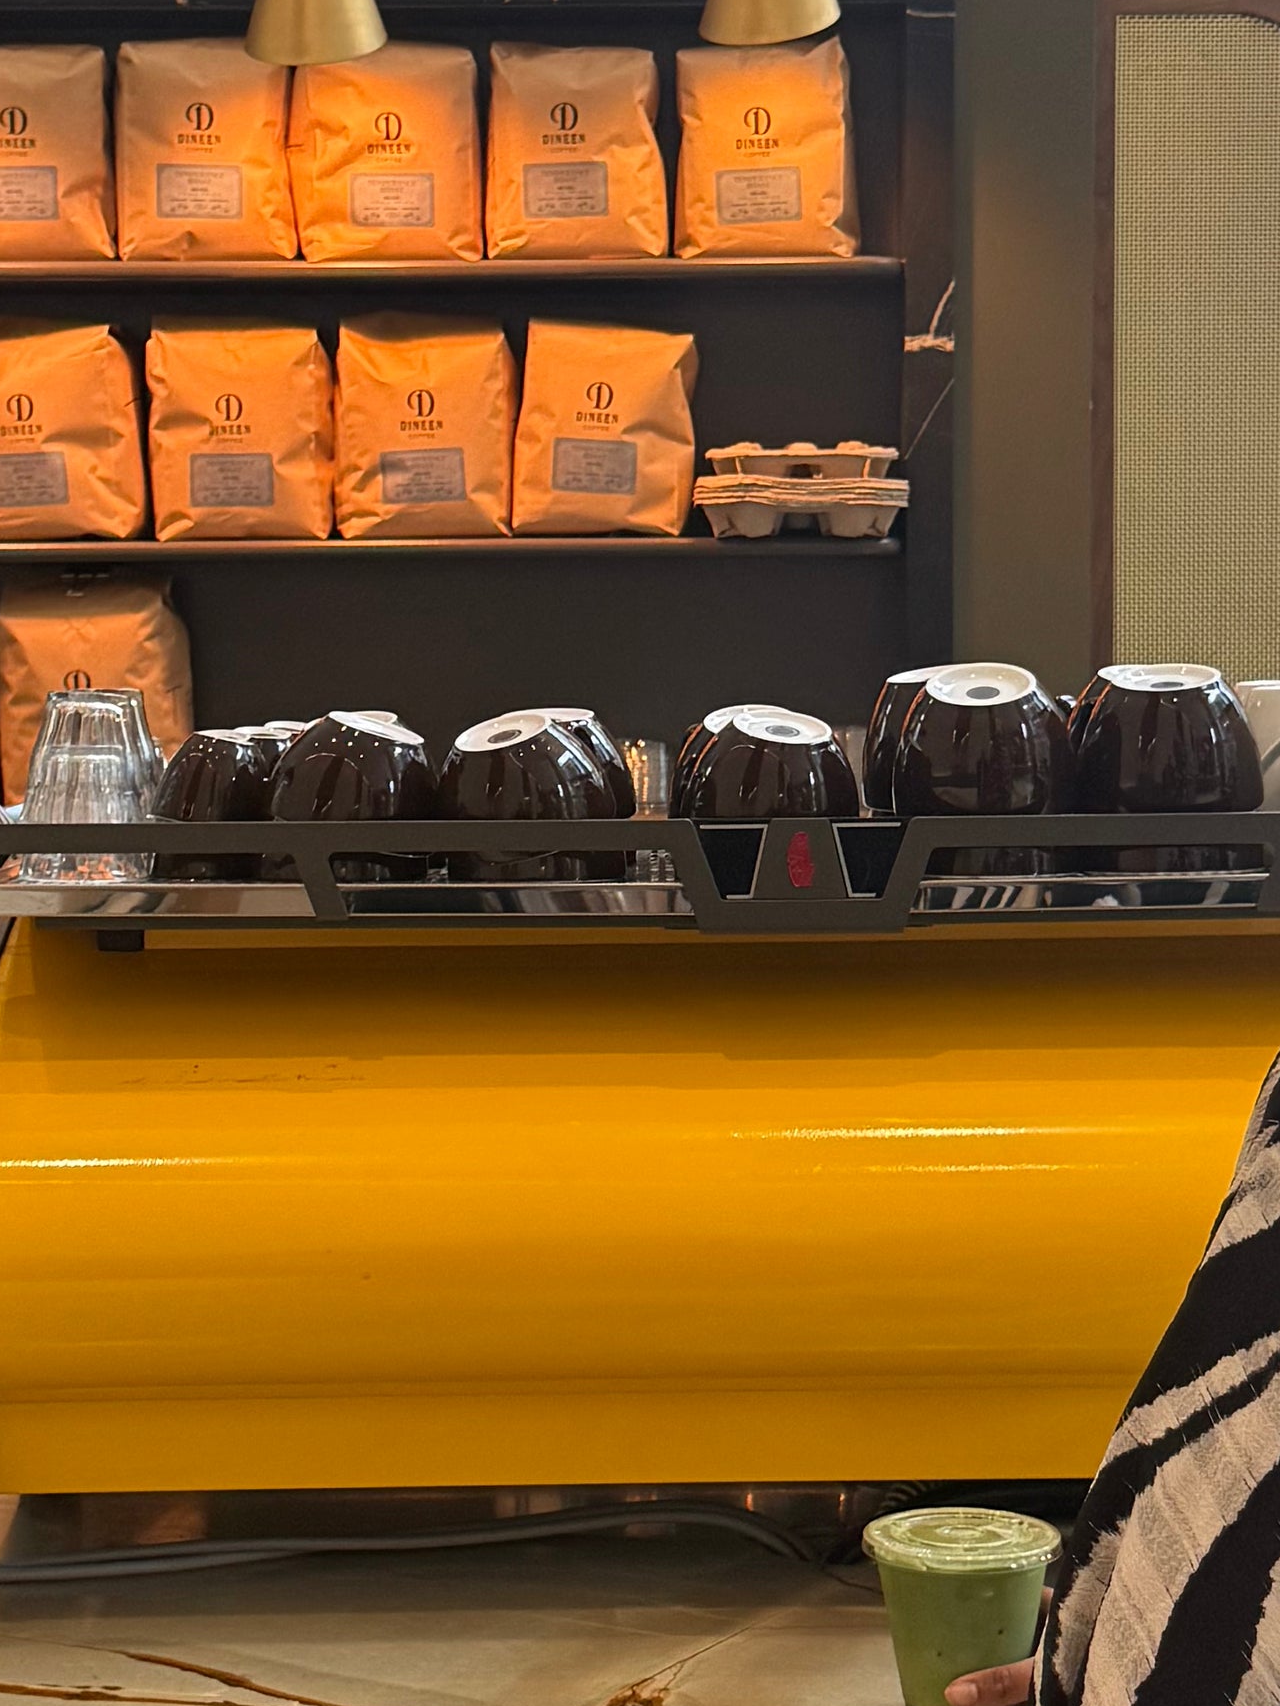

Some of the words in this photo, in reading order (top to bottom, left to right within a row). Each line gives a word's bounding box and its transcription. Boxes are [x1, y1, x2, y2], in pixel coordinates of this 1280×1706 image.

[177, 134, 221, 145] DINEEN
[542, 134, 586, 145] DINEEN
[735, 138, 779, 150] DINEEN
[366, 144, 411, 154] DINEEN
[576, 411, 619, 424] DINEEN
[400, 420, 443, 431] DINEEN
